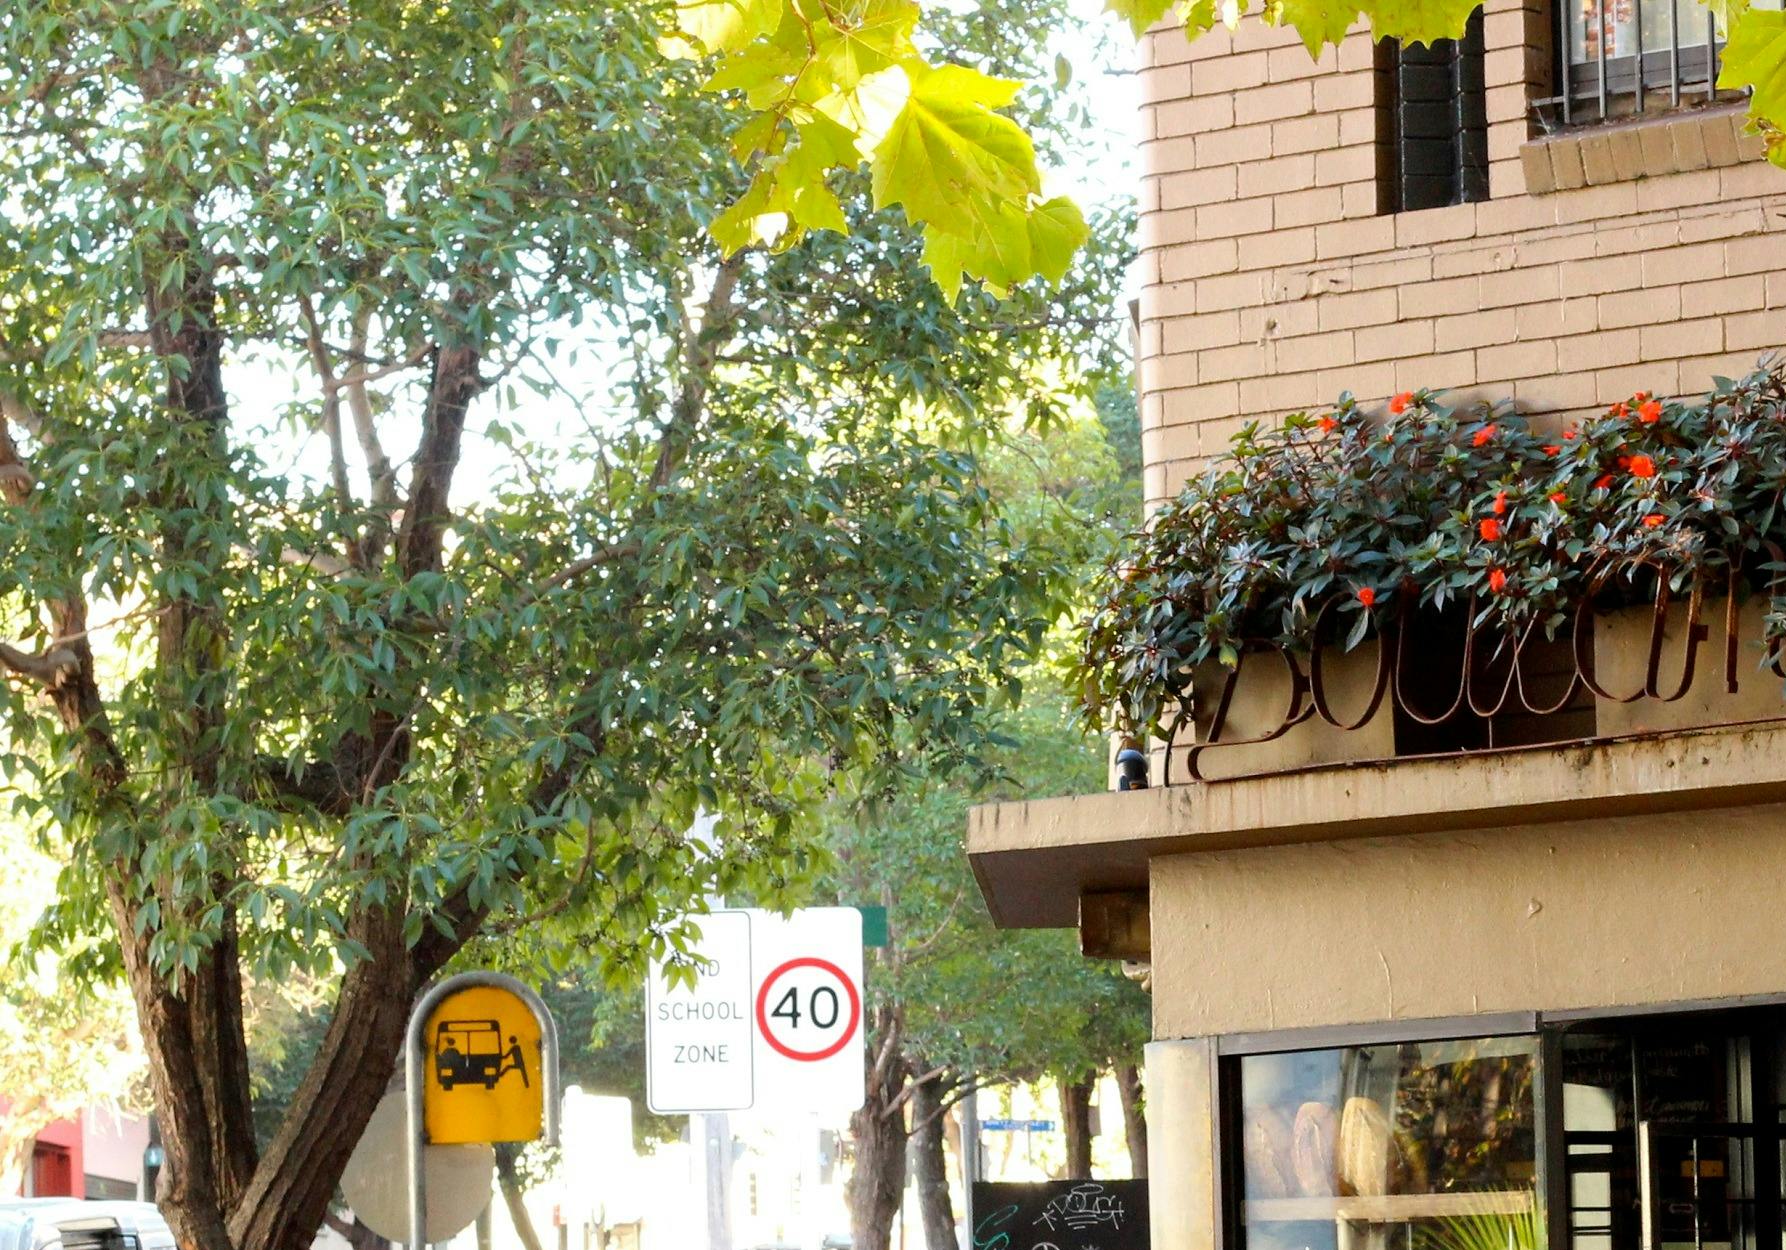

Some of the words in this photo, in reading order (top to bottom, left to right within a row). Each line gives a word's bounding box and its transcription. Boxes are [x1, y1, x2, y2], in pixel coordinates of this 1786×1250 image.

[688, 959, 720, 977] ND
[658, 1001, 744, 1021] SCHOOL
[770, 986, 839, 1029] 40
[673, 1044, 729, 1063] ZONE
